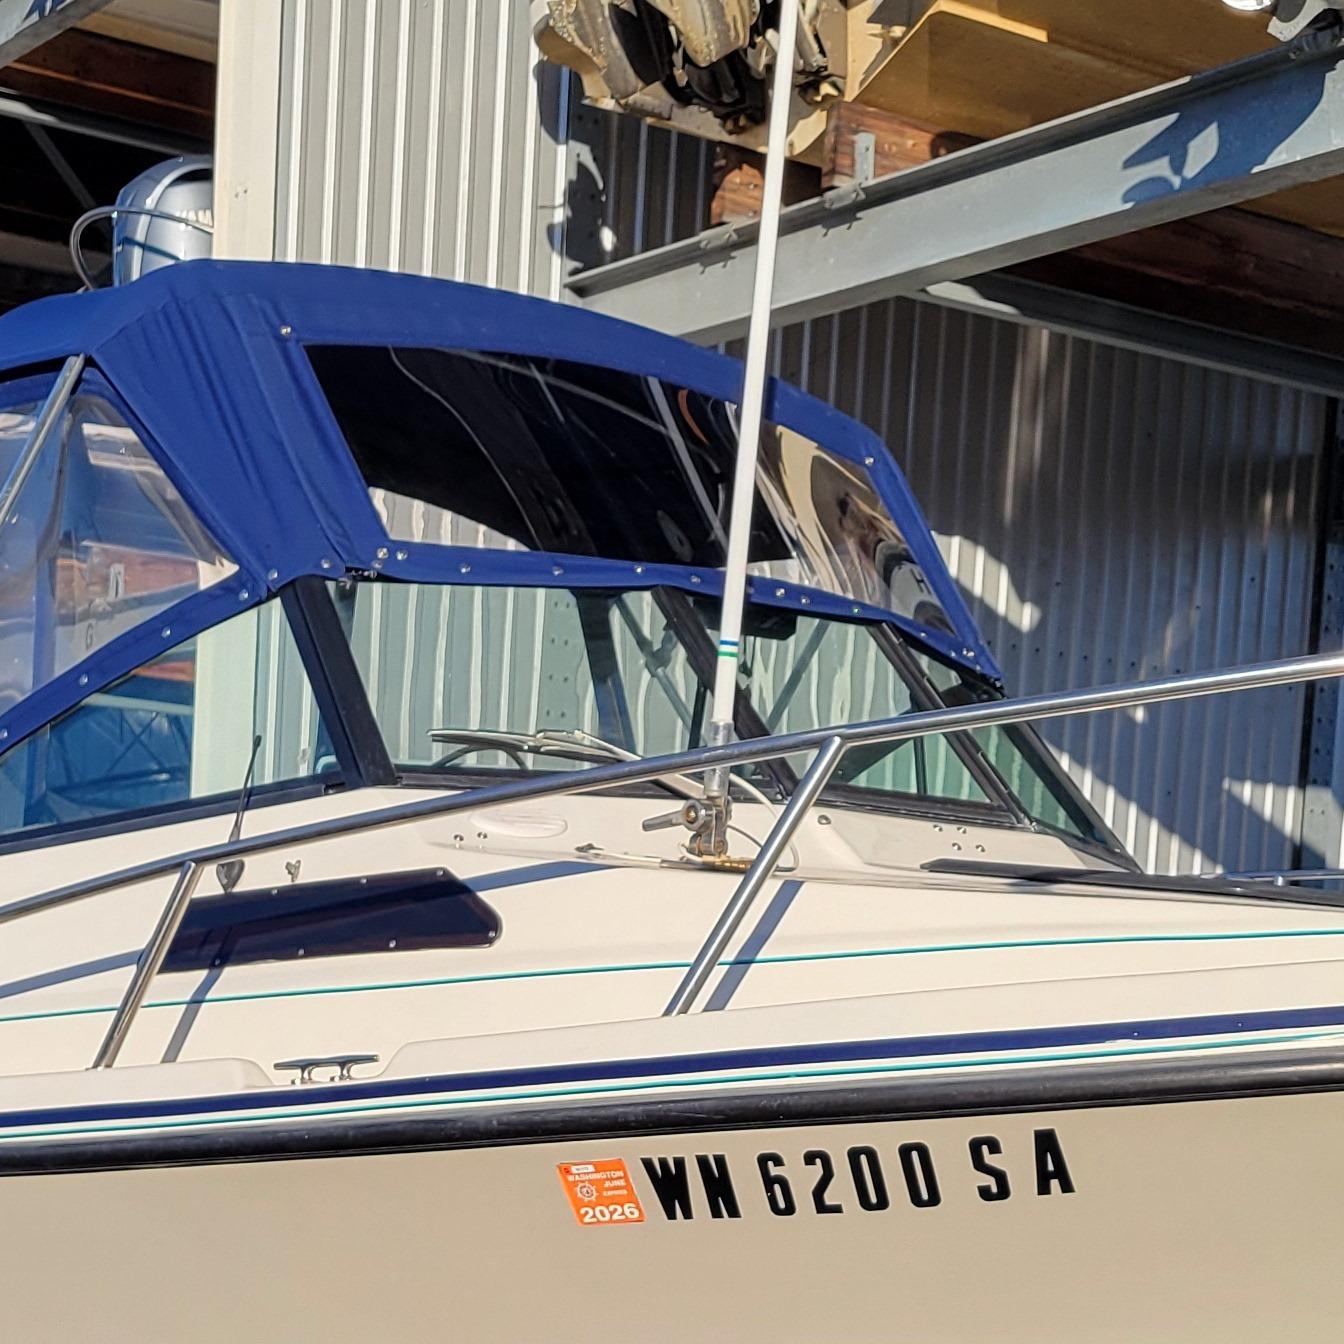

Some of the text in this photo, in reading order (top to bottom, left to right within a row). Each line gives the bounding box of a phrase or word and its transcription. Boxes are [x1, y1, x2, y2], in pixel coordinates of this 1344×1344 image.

[567, 1169, 625, 1182] WASHINGTON
[603, 1179, 627, 1188] JUNE
[640, 1153, 742, 1221] WN
[756, 1140, 942, 1217] 6200
[579, 1202, 641, 1223] 2026
